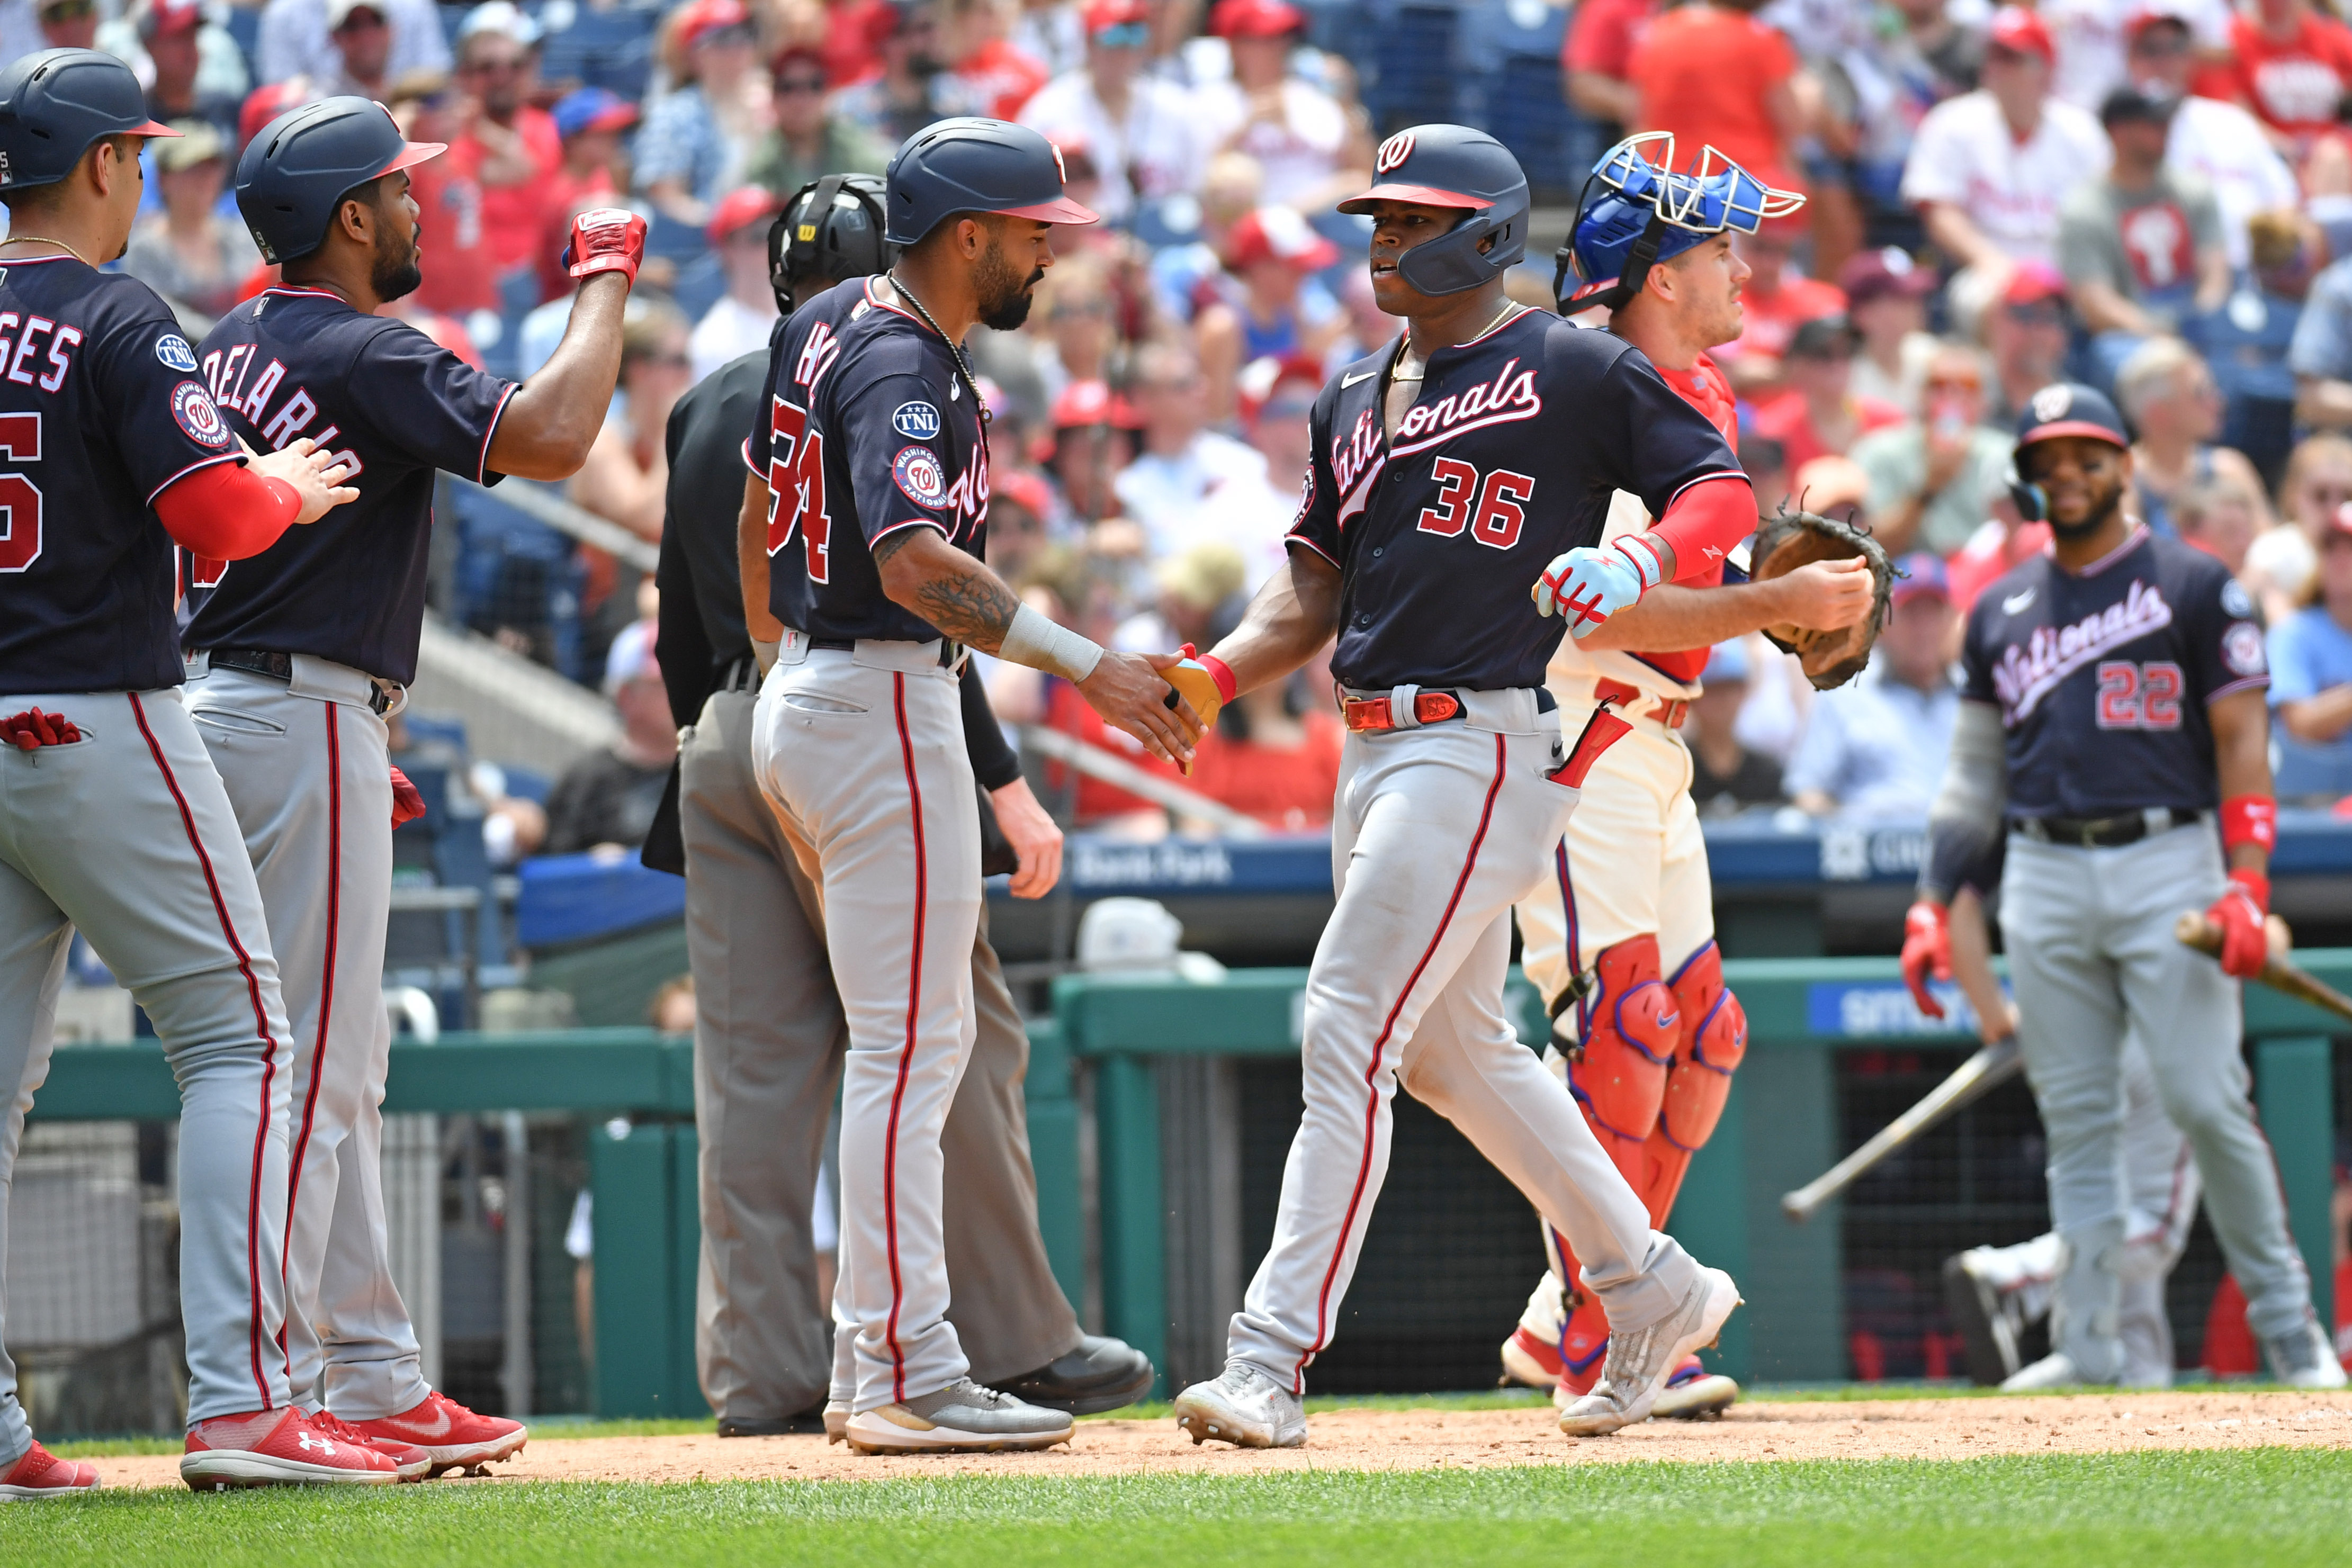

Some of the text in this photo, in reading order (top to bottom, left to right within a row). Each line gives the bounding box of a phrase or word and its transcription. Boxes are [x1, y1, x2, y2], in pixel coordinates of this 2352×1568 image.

[159, 345, 198, 365] TNL
[896, 413, 938, 430] TNL
[896, 448, 944, 479] WASHINGTON
[903, 484, 947, 507] NATIONALS
[1416, 455, 1536, 551] 36
[1991, 578, 2173, 729] Nationals
[2096, 660, 2183, 730] 22
